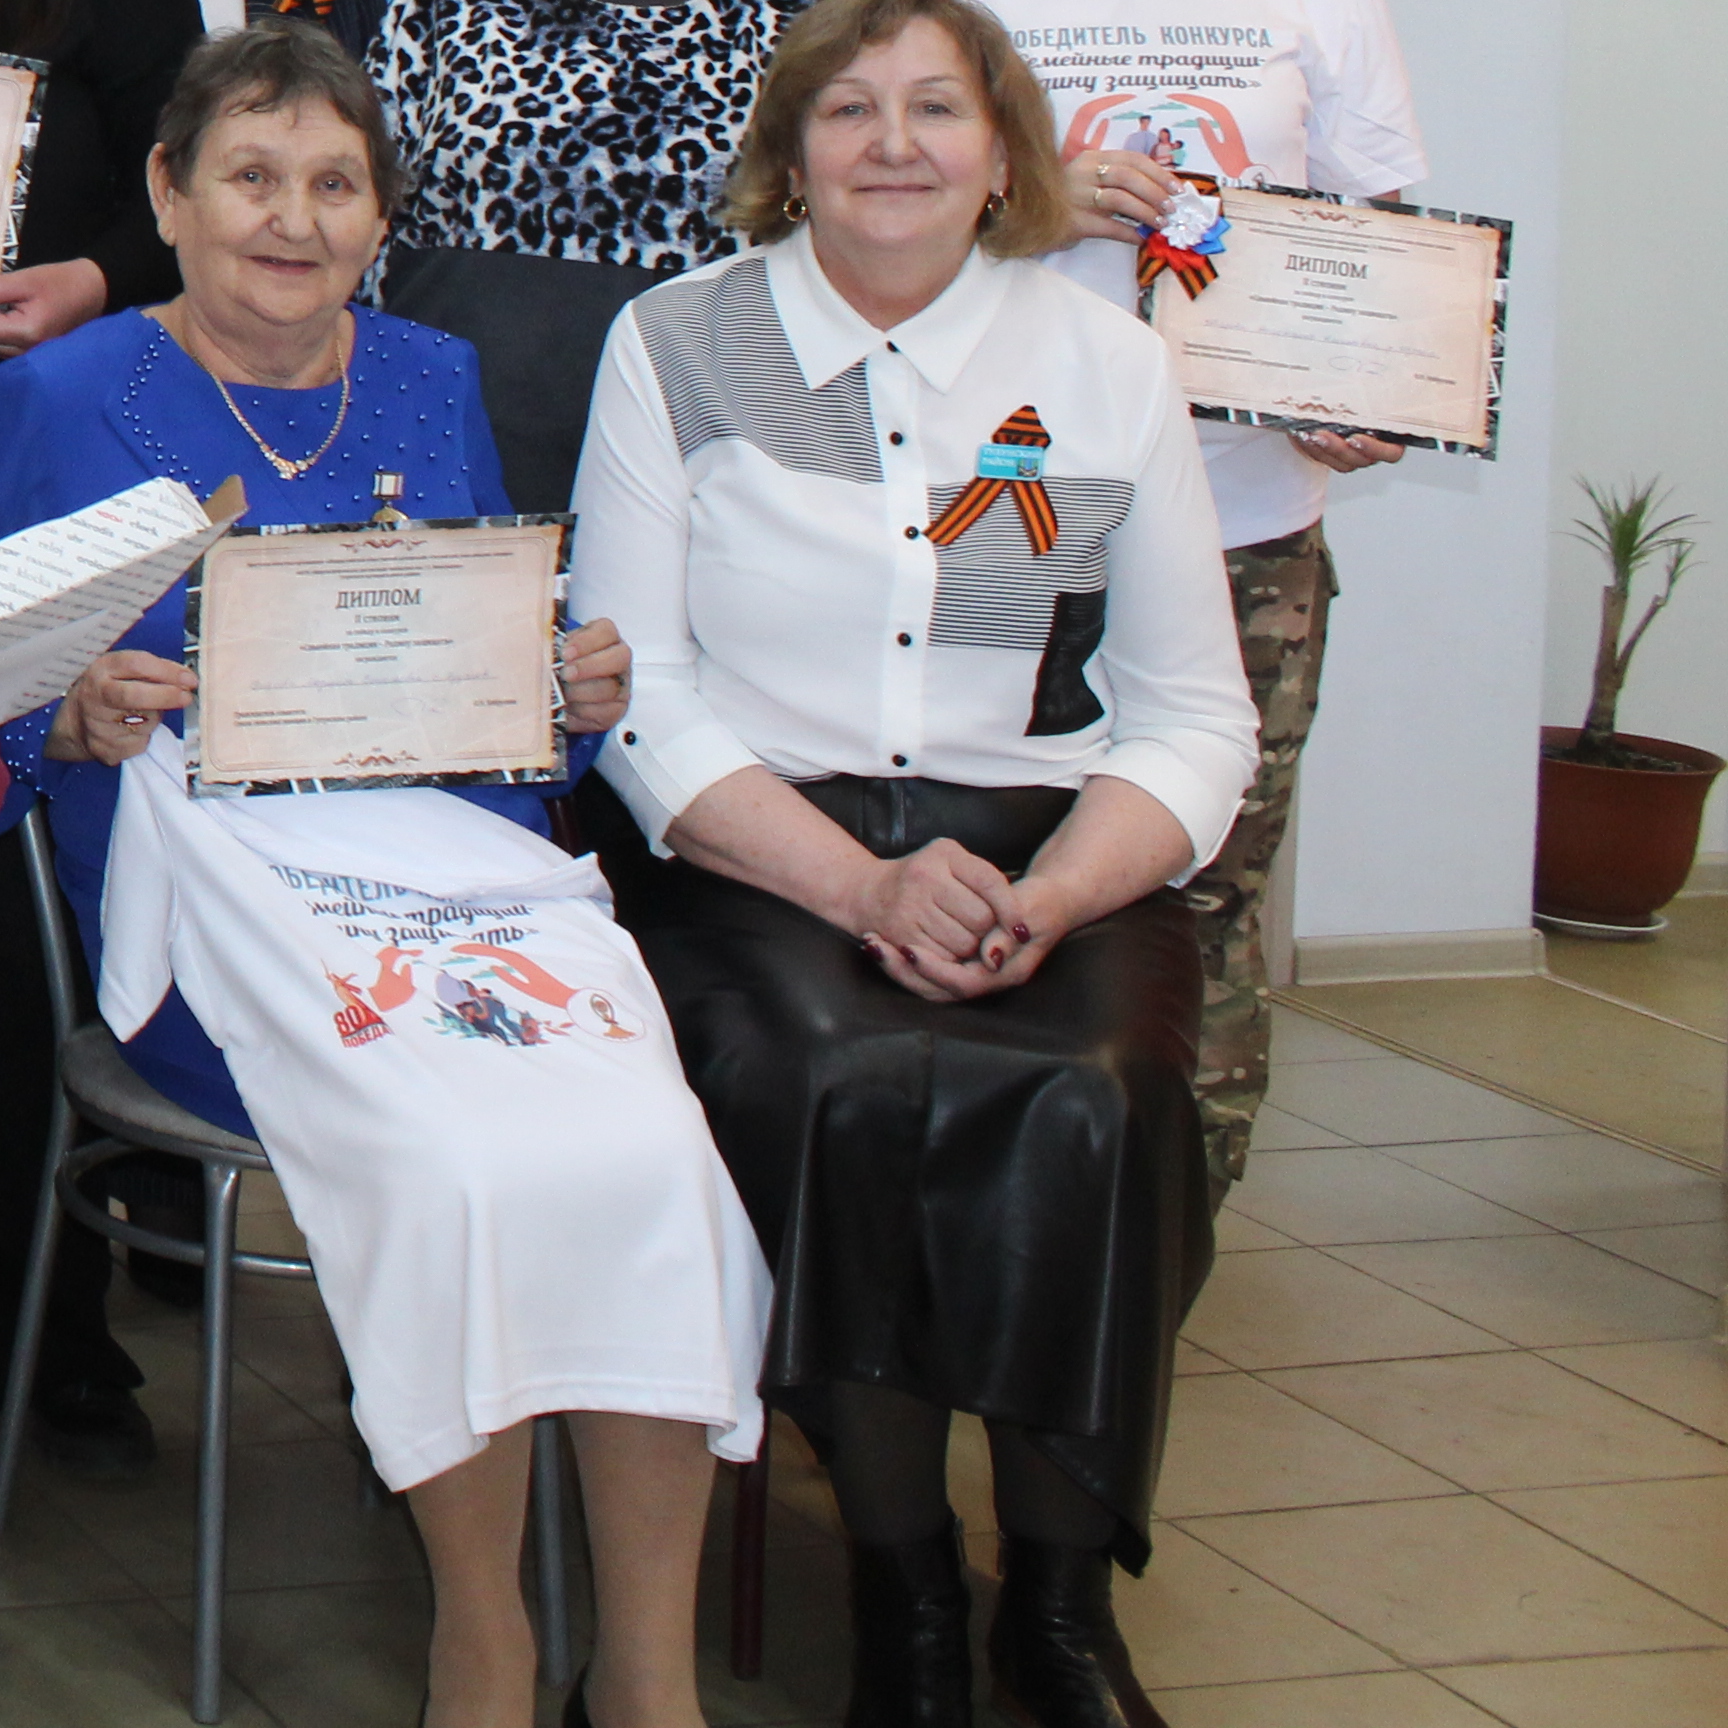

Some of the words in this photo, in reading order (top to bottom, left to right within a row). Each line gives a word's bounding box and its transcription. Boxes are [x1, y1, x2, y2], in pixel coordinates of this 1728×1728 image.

[1160, 26, 1273, 48] КОНКУРСА
[1138, 52, 1266, 71] традиции-
[1104, 72, 1262, 93] защищать»
[1284, 252, 1368, 282] ДИПЛОМ
[334, 587, 422, 609] ДИПЛОМ
[333, 1005, 363, 1037] 80
